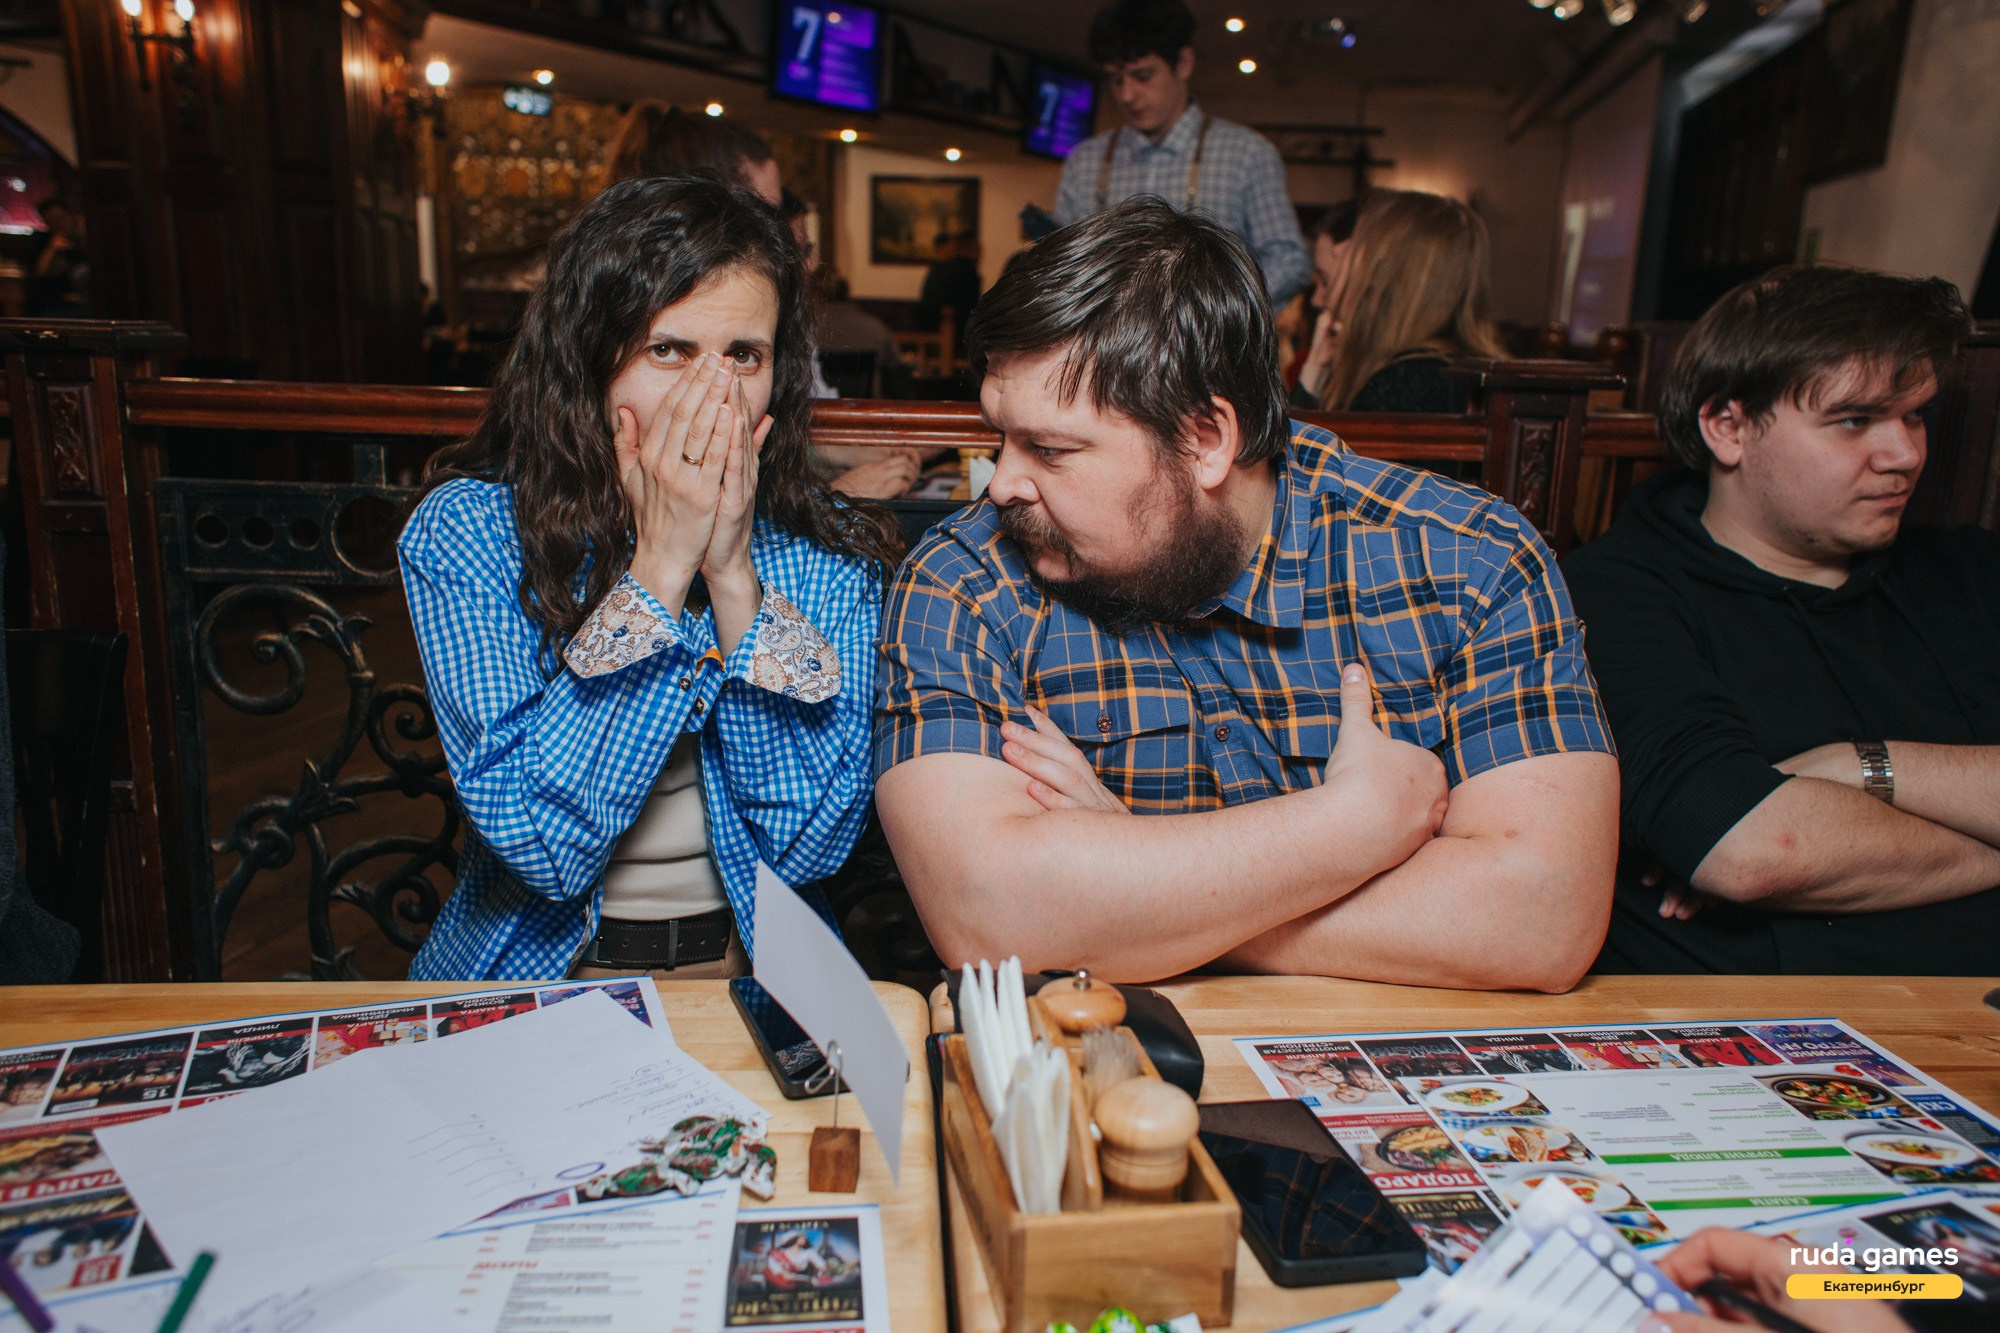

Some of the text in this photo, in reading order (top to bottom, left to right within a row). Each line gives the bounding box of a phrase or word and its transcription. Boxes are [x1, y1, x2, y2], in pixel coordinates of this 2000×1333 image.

[791, 6, 821, 61] 7
[455, 995, 512, 1005] КОРОВКА
[459, 1006, 497, 1015] МАРТА
[357, 1013, 390, 1021] ДЕНЬ
[233, 1022, 281, 1035] ЛИНДА
[347, 1019, 385, 1028] МАРТА
[227, 1032, 274, 1044] АПРЕЛЯ
[1775, 1041, 1861, 1051] РЕТРО FM
[1785, 1049, 1873, 1058] ВЕЧЕРИНКА
[141, 1087, 169, 1100] 15
[1669, 1151, 1782, 1161] ГОРЯЧИЕ БЛЮДА
[1373, 1172, 1474, 1188] ПОДАРО
[1748, 1197, 1809, 1206] САЛАТЫ
